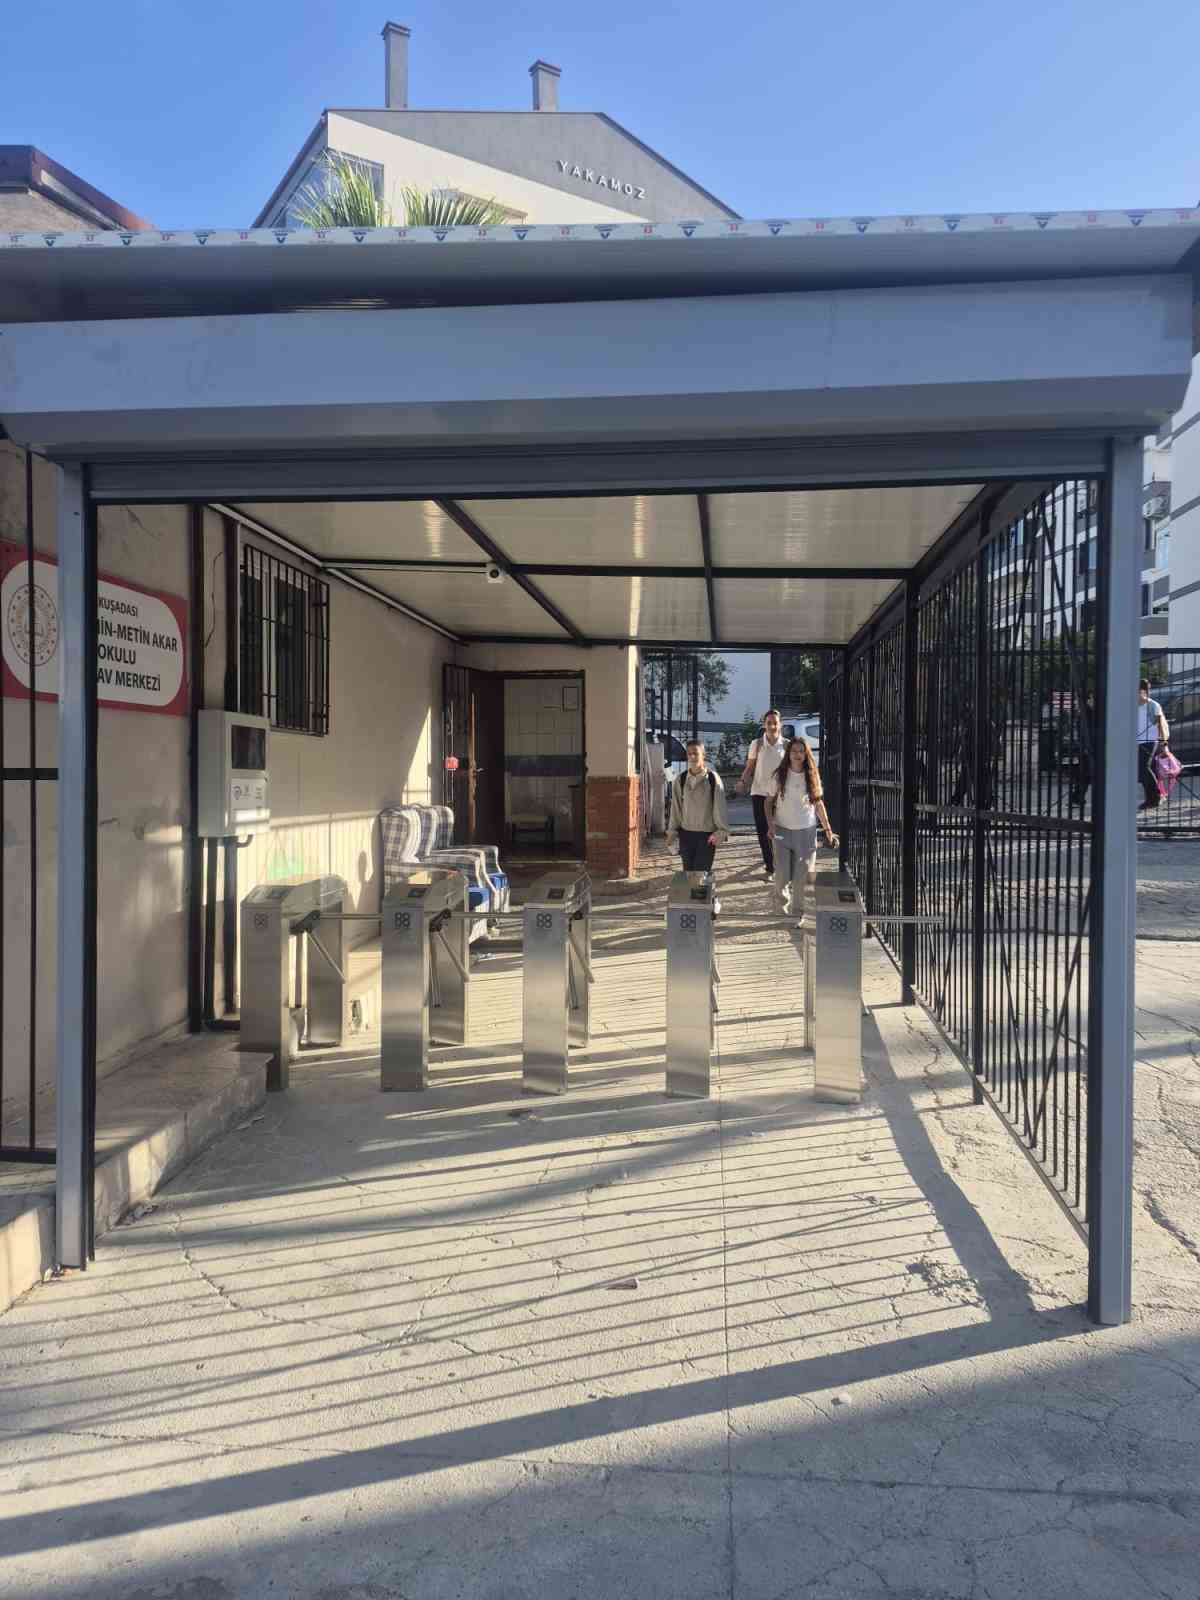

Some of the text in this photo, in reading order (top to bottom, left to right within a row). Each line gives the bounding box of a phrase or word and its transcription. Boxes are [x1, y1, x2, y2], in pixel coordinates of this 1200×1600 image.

[557, 159, 645, 200] YAKAMOZ
[152, 632, 178, 653] AKAR
[97, 644, 136, 665] OKULU
[115, 669, 161, 692] MERKEZİ
